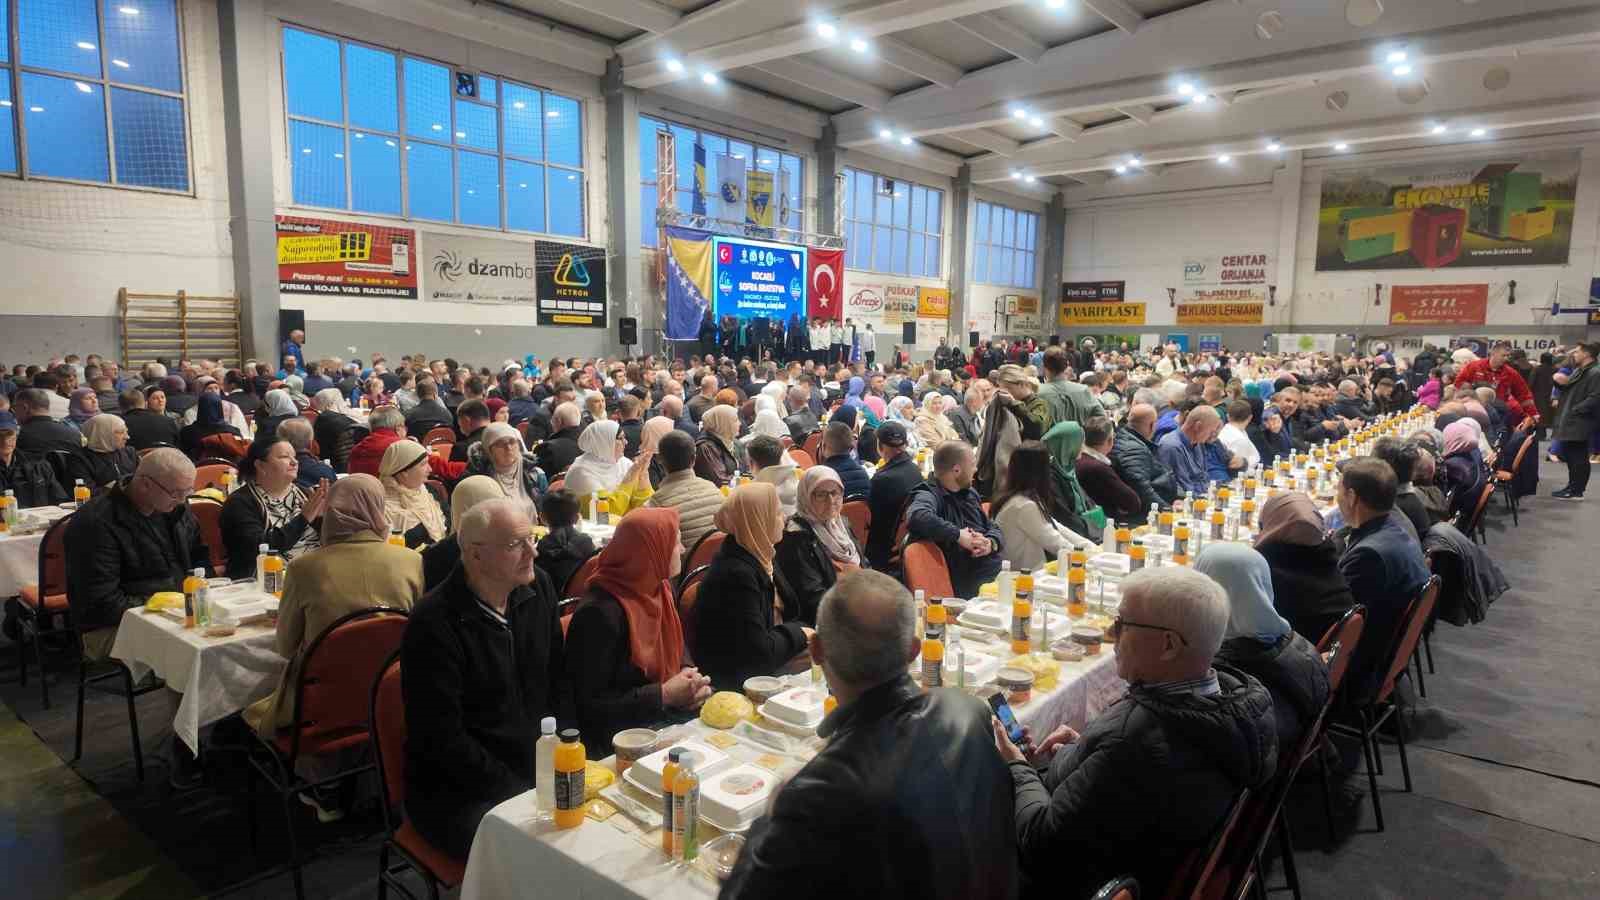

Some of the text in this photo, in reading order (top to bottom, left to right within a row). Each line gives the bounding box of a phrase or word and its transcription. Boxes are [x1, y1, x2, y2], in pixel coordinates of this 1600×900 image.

[1222, 255, 1266, 266] CENTAR
[1221, 269, 1266, 280] GRIJANJA
[280, 283, 311, 291] FIRMA
[342, 286, 360, 294] VAS
[556, 289, 589, 297] METRON
[1419, 298, 1457, 308] STIL
[1073, 305, 1140, 317] VARIPLAST
[1189, 304, 1217, 316] KLAUS
[1525, 339, 1557, 349] LIGA
